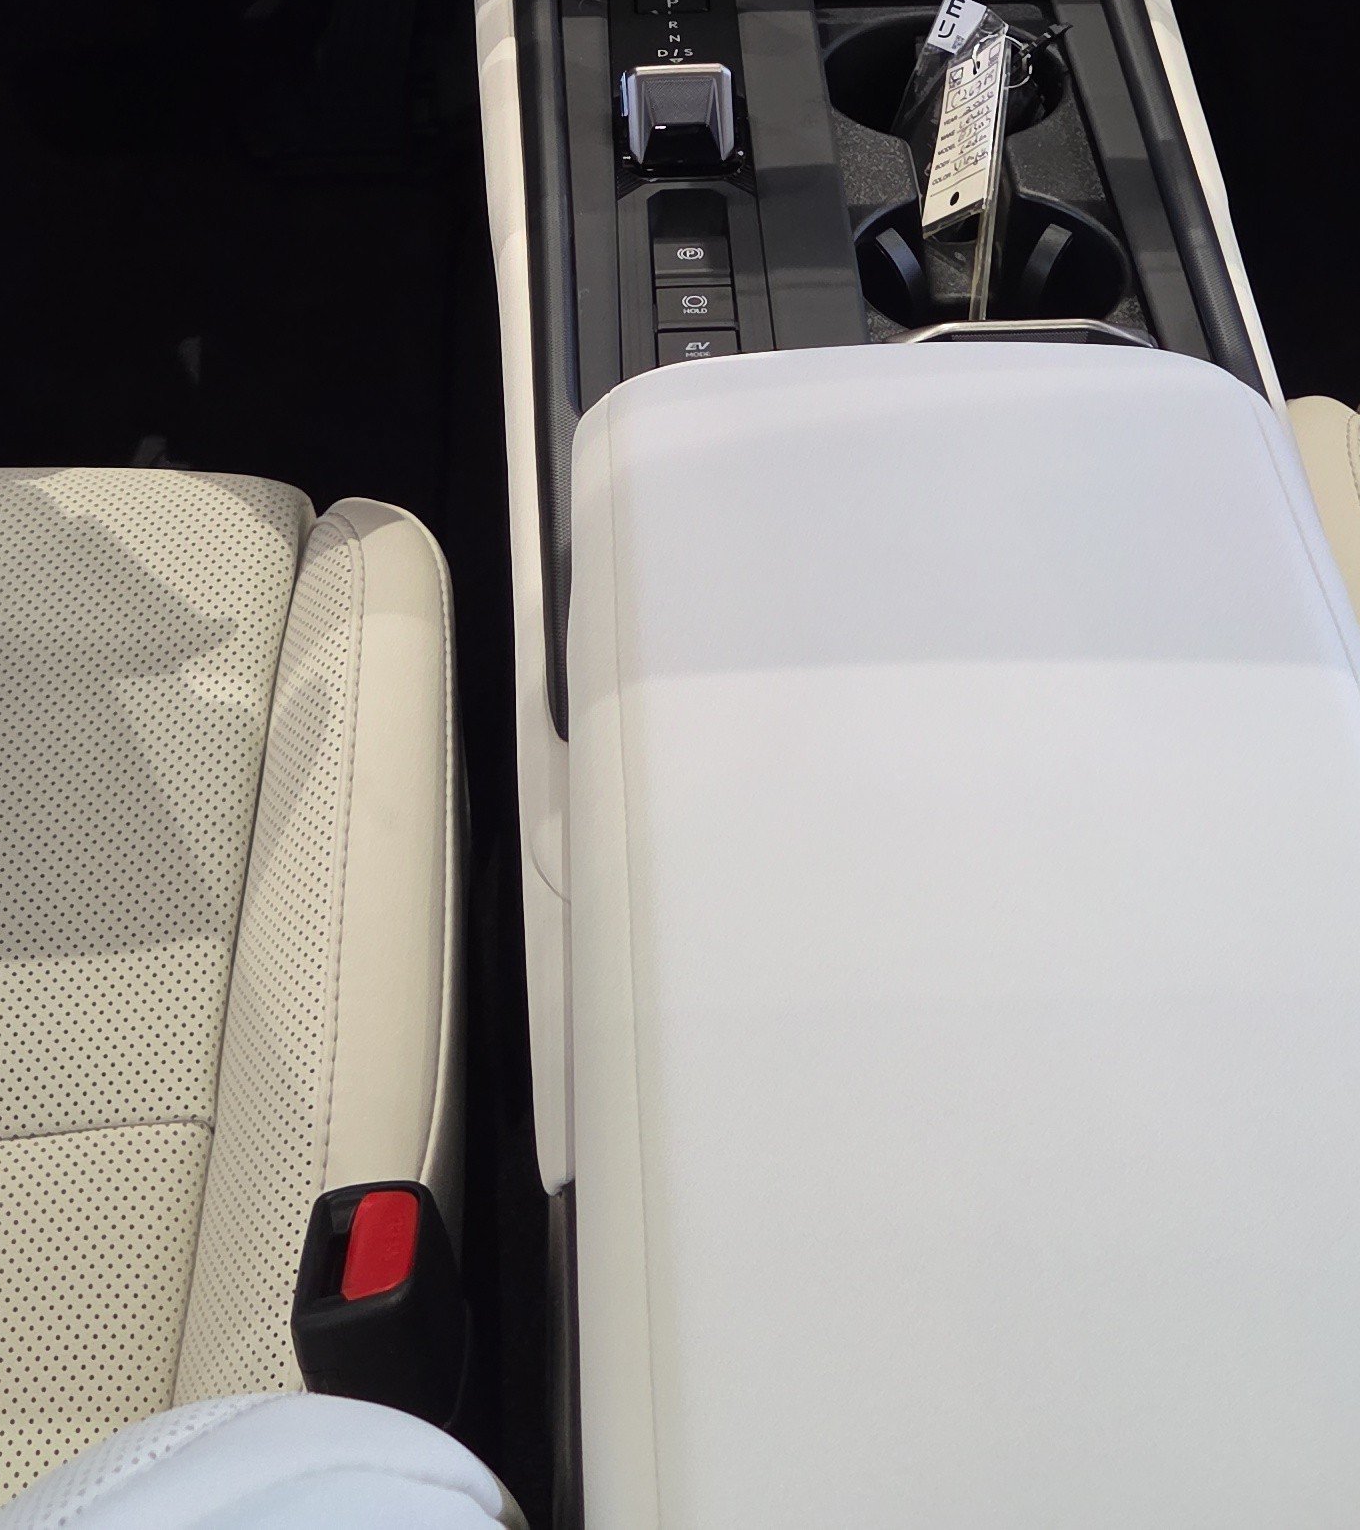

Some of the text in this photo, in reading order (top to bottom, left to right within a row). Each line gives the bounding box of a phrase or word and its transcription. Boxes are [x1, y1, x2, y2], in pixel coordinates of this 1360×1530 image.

[668, 21, 678, 29] R
[669, 34, 681, 43] N
[685, 341, 710, 351] EV
